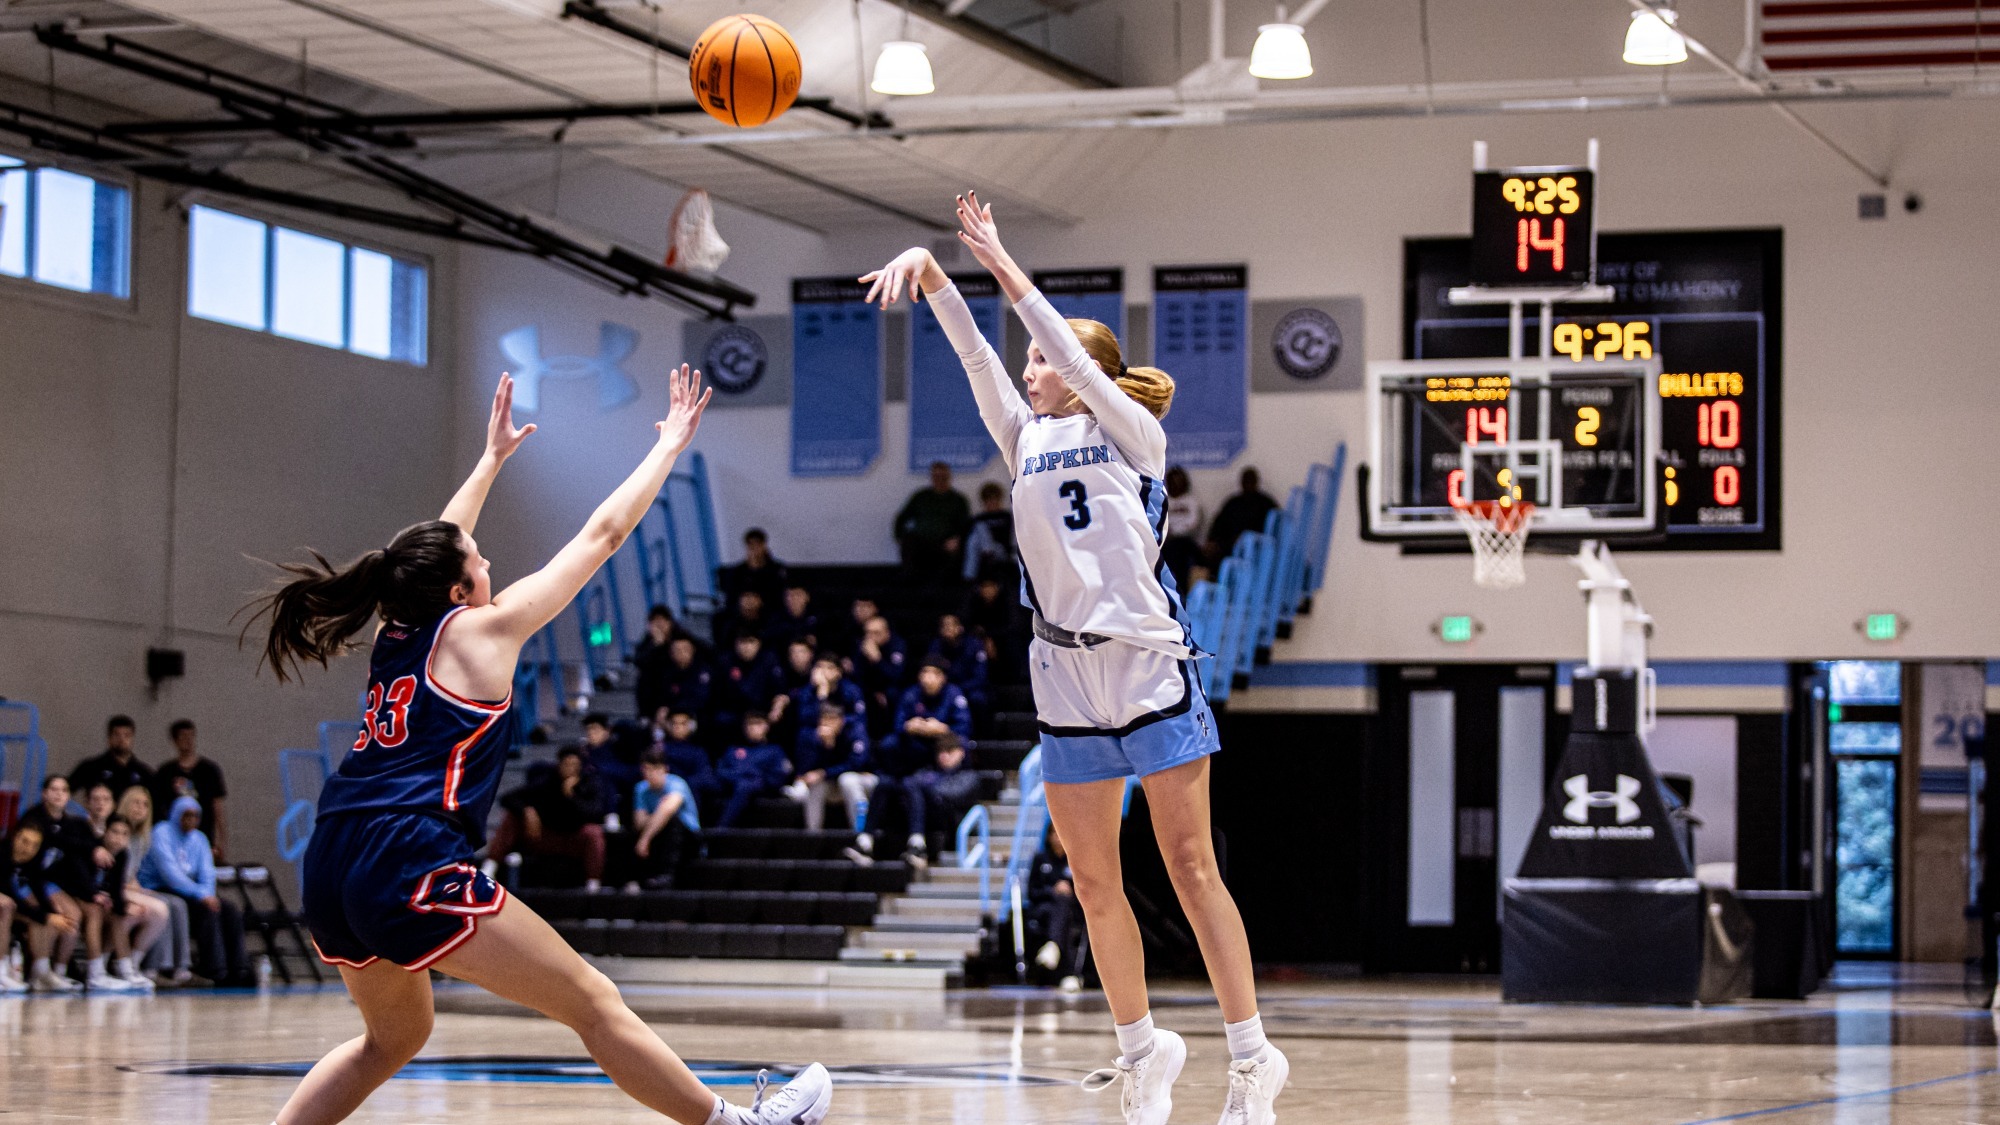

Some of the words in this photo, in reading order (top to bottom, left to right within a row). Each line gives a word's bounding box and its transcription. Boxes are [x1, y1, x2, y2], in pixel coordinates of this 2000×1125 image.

[1502, 177, 1580, 214] 9:25
[1517, 218, 1565, 272] 14
[1553, 321, 1653, 363] 9:26
[1466, 406, 1507, 448] 14
[1574, 407, 1600, 446] 2
[1697, 400, 1740, 449] 10
[1023, 445, 1117, 476] HOPKIN
[1058, 478, 1093, 532] 3
[1713, 465, 1740, 506] 0
[352, 673, 418, 752] 33
